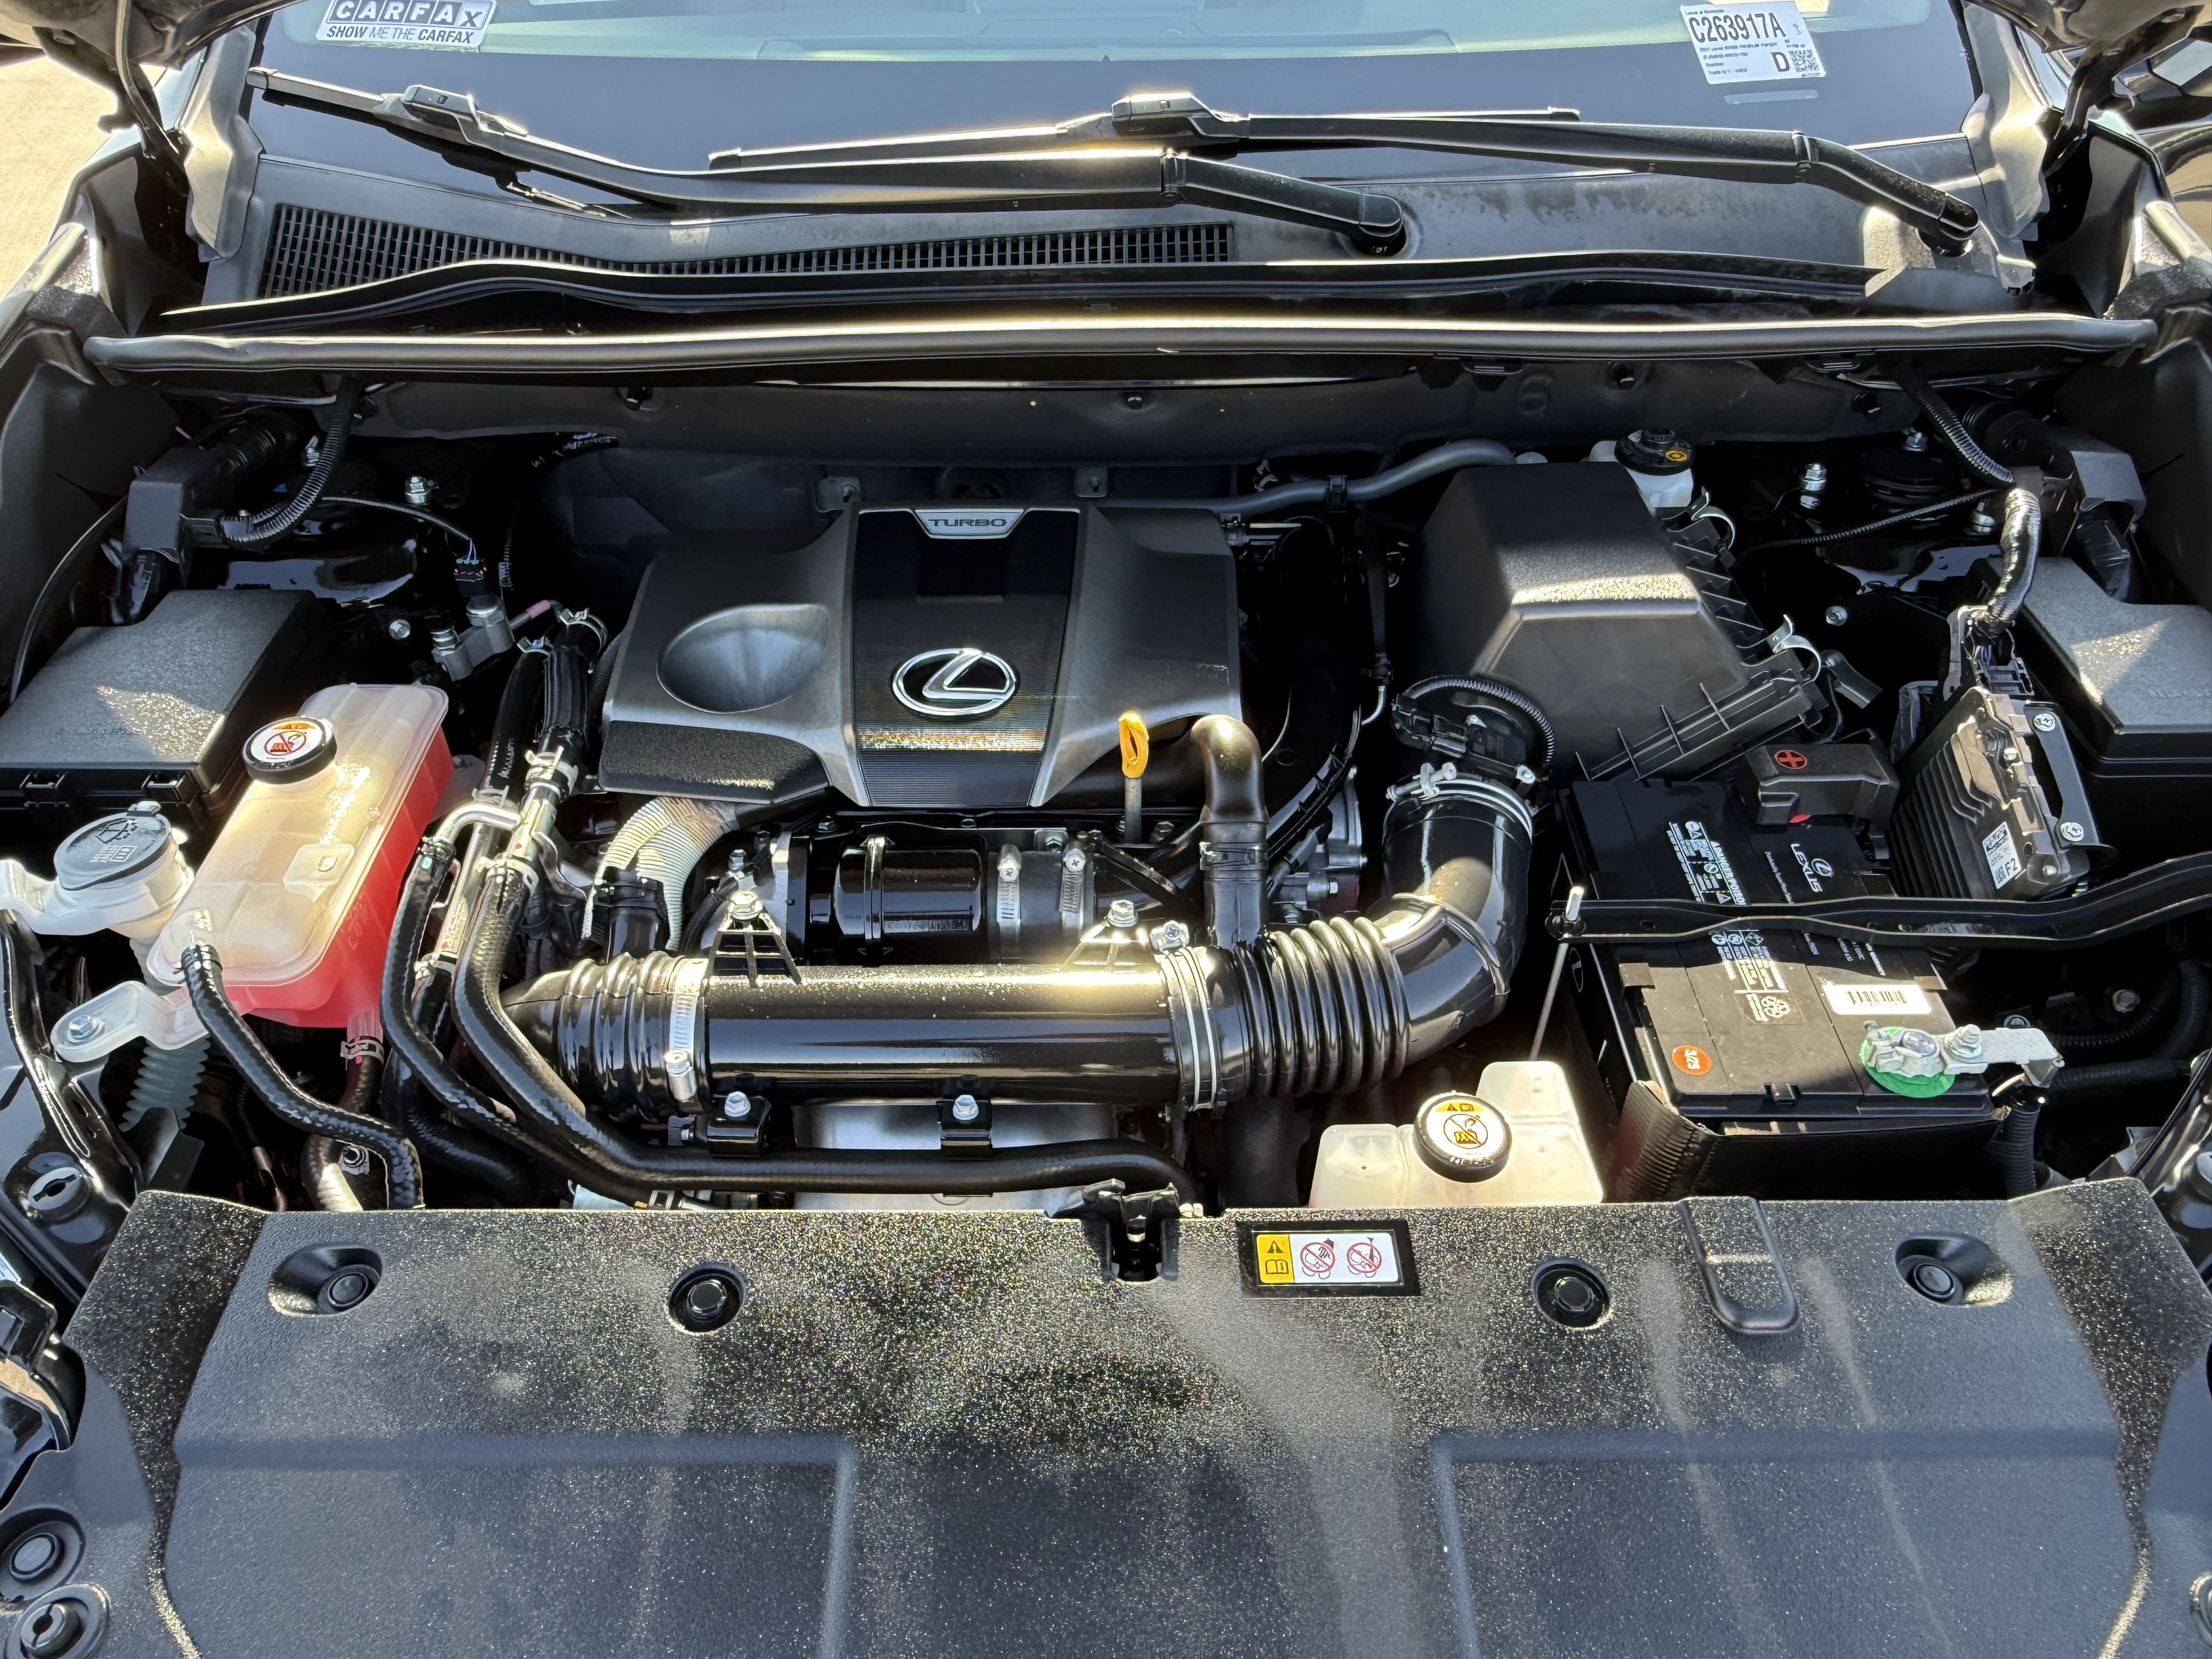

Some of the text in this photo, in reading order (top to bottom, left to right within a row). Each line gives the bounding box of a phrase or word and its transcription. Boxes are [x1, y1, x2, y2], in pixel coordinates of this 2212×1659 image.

[336, 1, 483, 27] CARFAX
[326, 25, 474, 44] SHOW ME THE CARFAX
[1689, 12, 1786, 43] C263917A
[1771, 52, 1790, 72] D
[928, 518, 1007, 527] TURBO
[1790, 843, 1823, 893] LEXUS
[1684, 1048, 1701, 1070] 3/25
